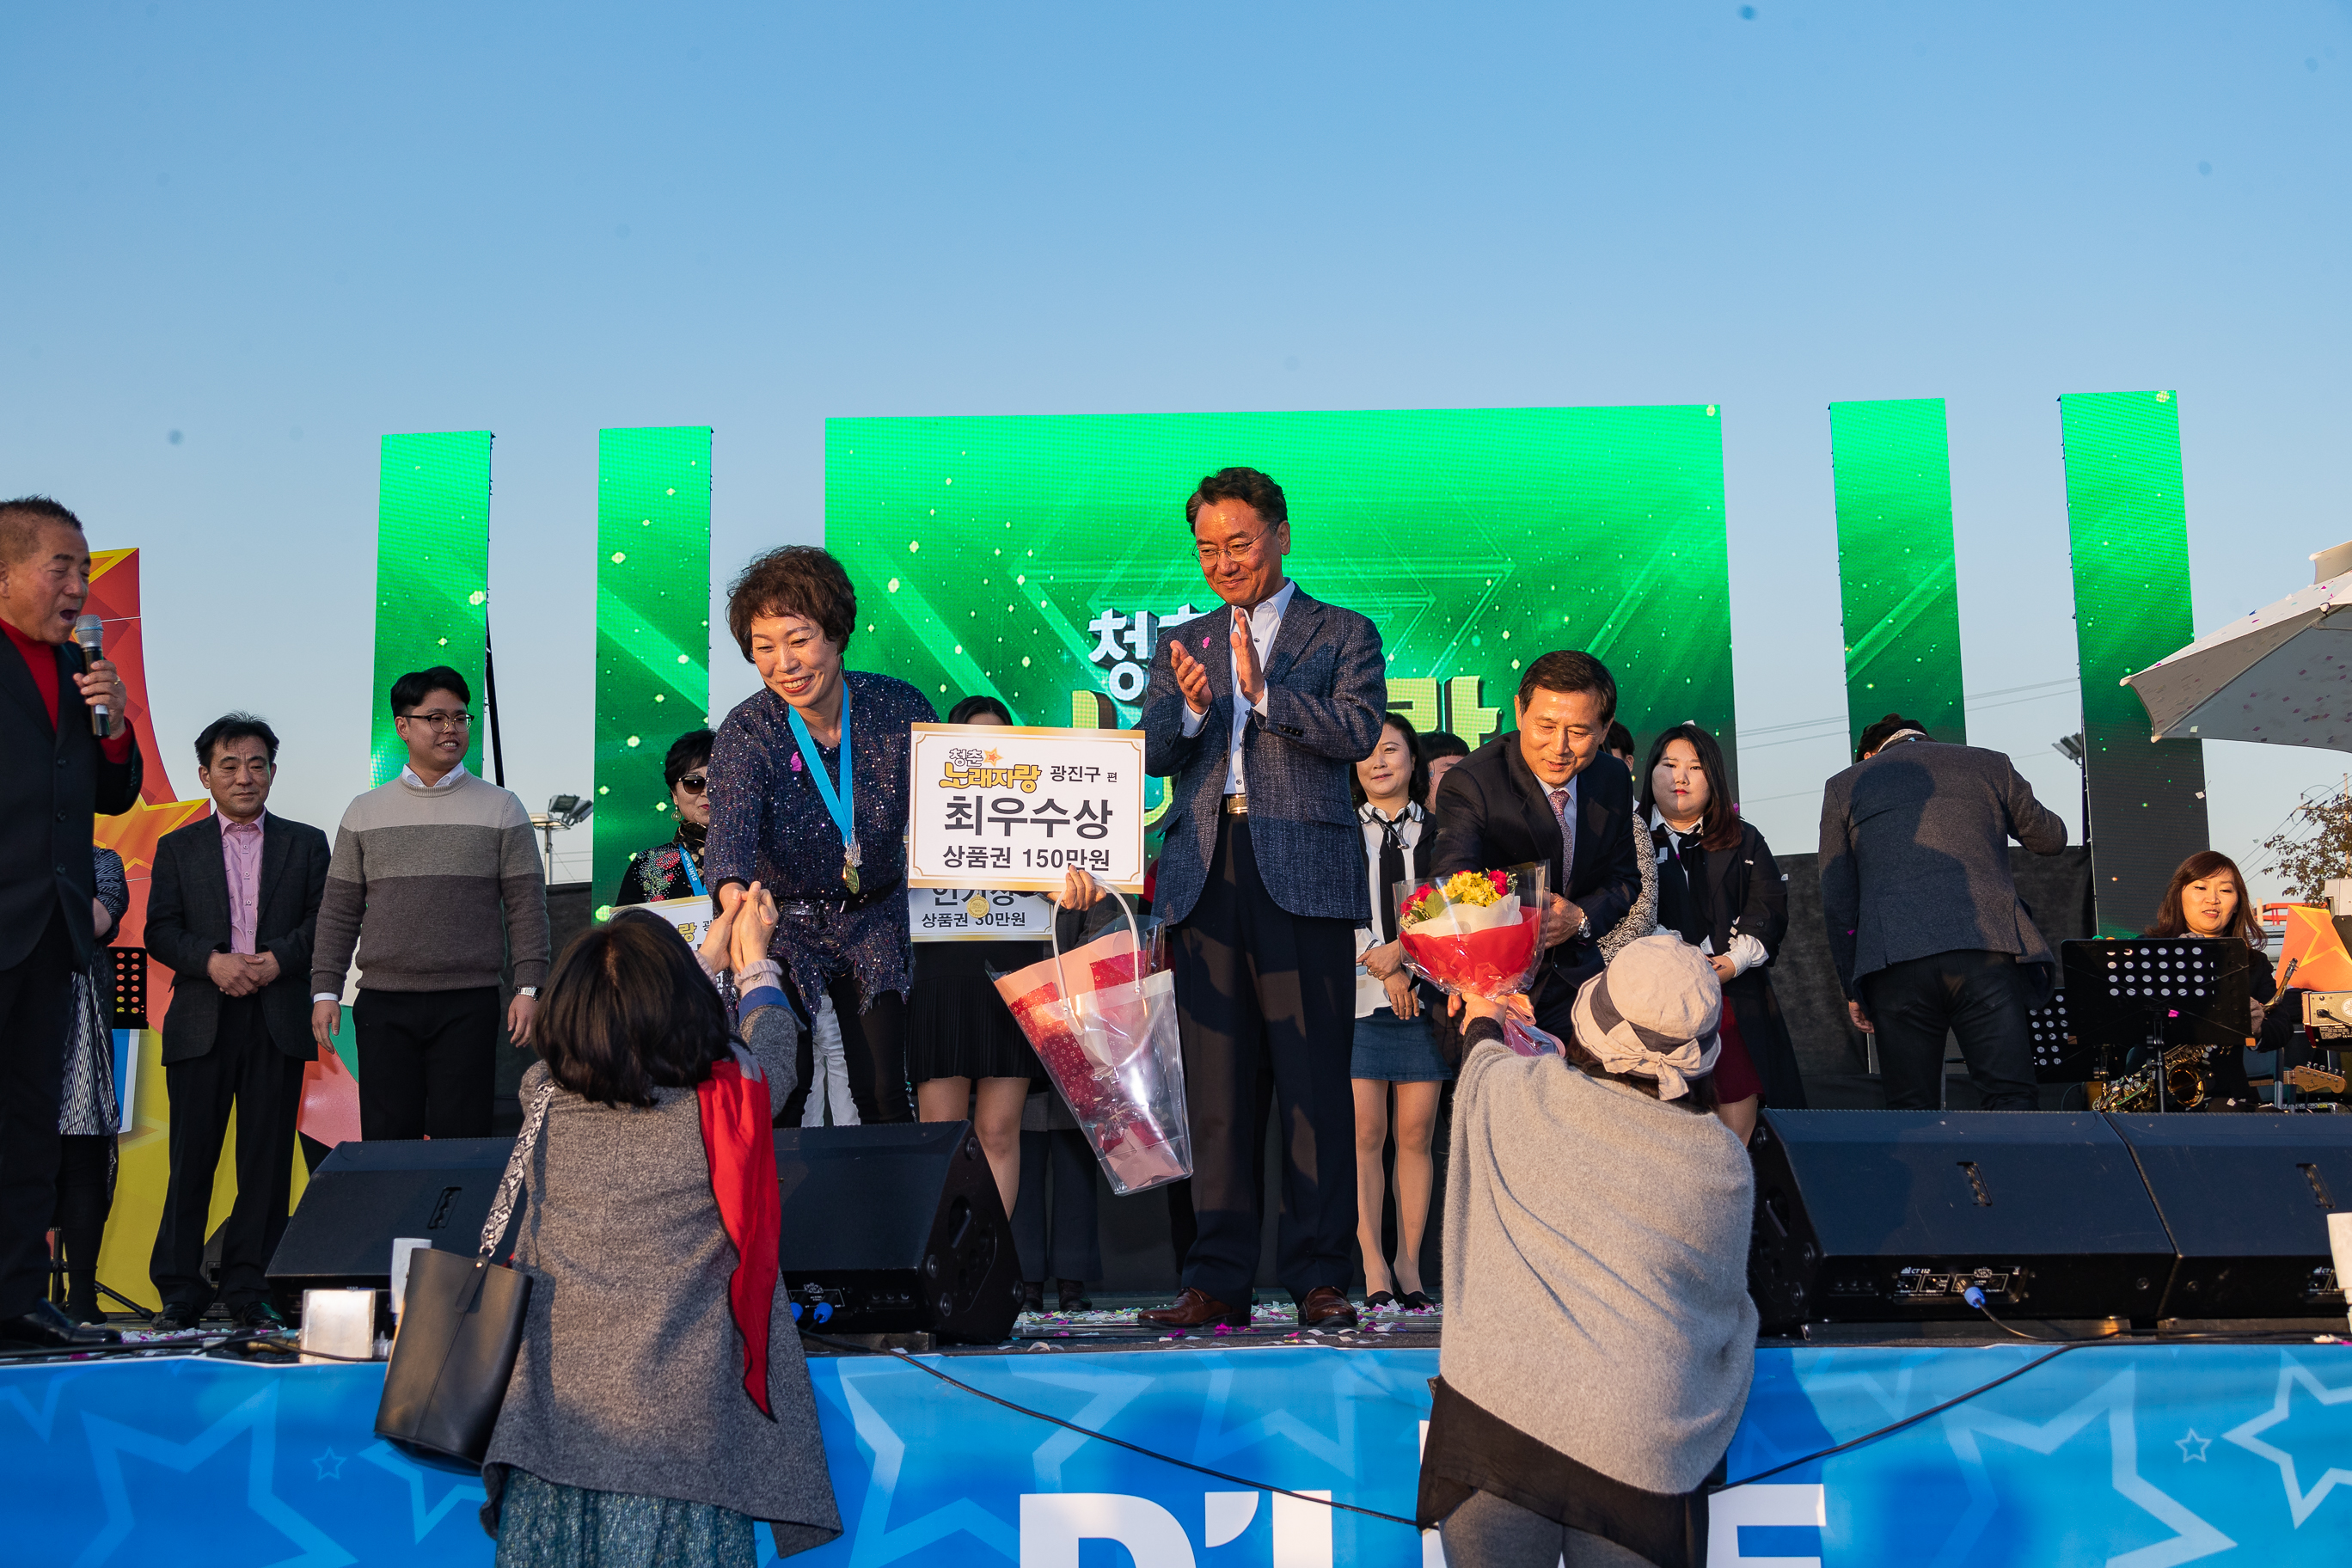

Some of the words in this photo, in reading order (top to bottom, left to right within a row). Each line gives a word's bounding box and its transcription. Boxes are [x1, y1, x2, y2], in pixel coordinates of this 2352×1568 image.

[949, 748, 983, 767] 청춘
[939, 762, 1043, 793] 노래자랑
[1050, 765, 1101, 783] 광진구
[1106, 771, 1118, 783] 편
[944, 795, 1113, 840] 최우수상
[943, 845, 1011, 869] 상품권
[1022, 848, 1110, 872] 150만원
[922, 912, 968, 928] 상품권
[975, 912, 1026, 927] 30만원
